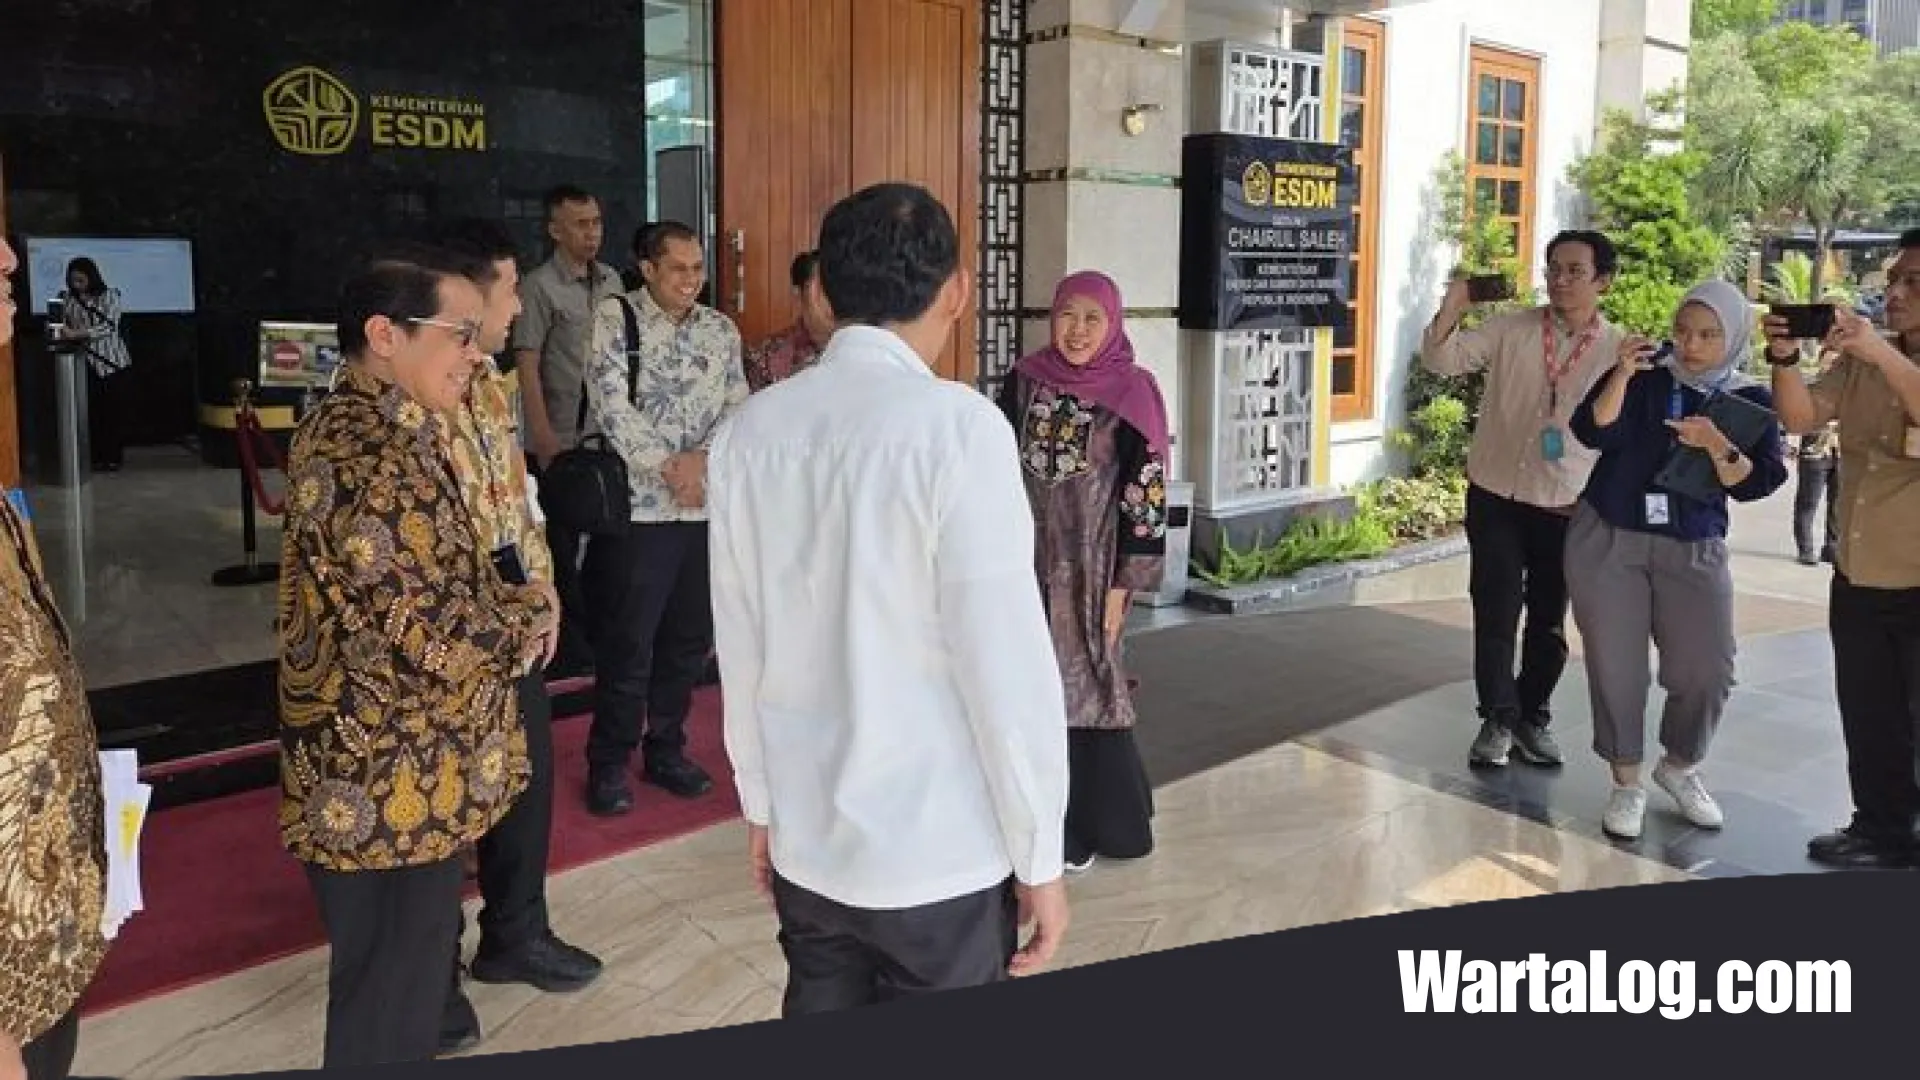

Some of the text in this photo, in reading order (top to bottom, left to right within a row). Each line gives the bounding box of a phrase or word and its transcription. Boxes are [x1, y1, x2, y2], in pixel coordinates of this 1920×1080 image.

[370, 95, 484, 116] KEMENTERIAN
[372, 111, 485, 151] ESDM
[1275, 178, 1337, 208] ESDM
[1228, 227, 1296, 248] CHAIRUL
